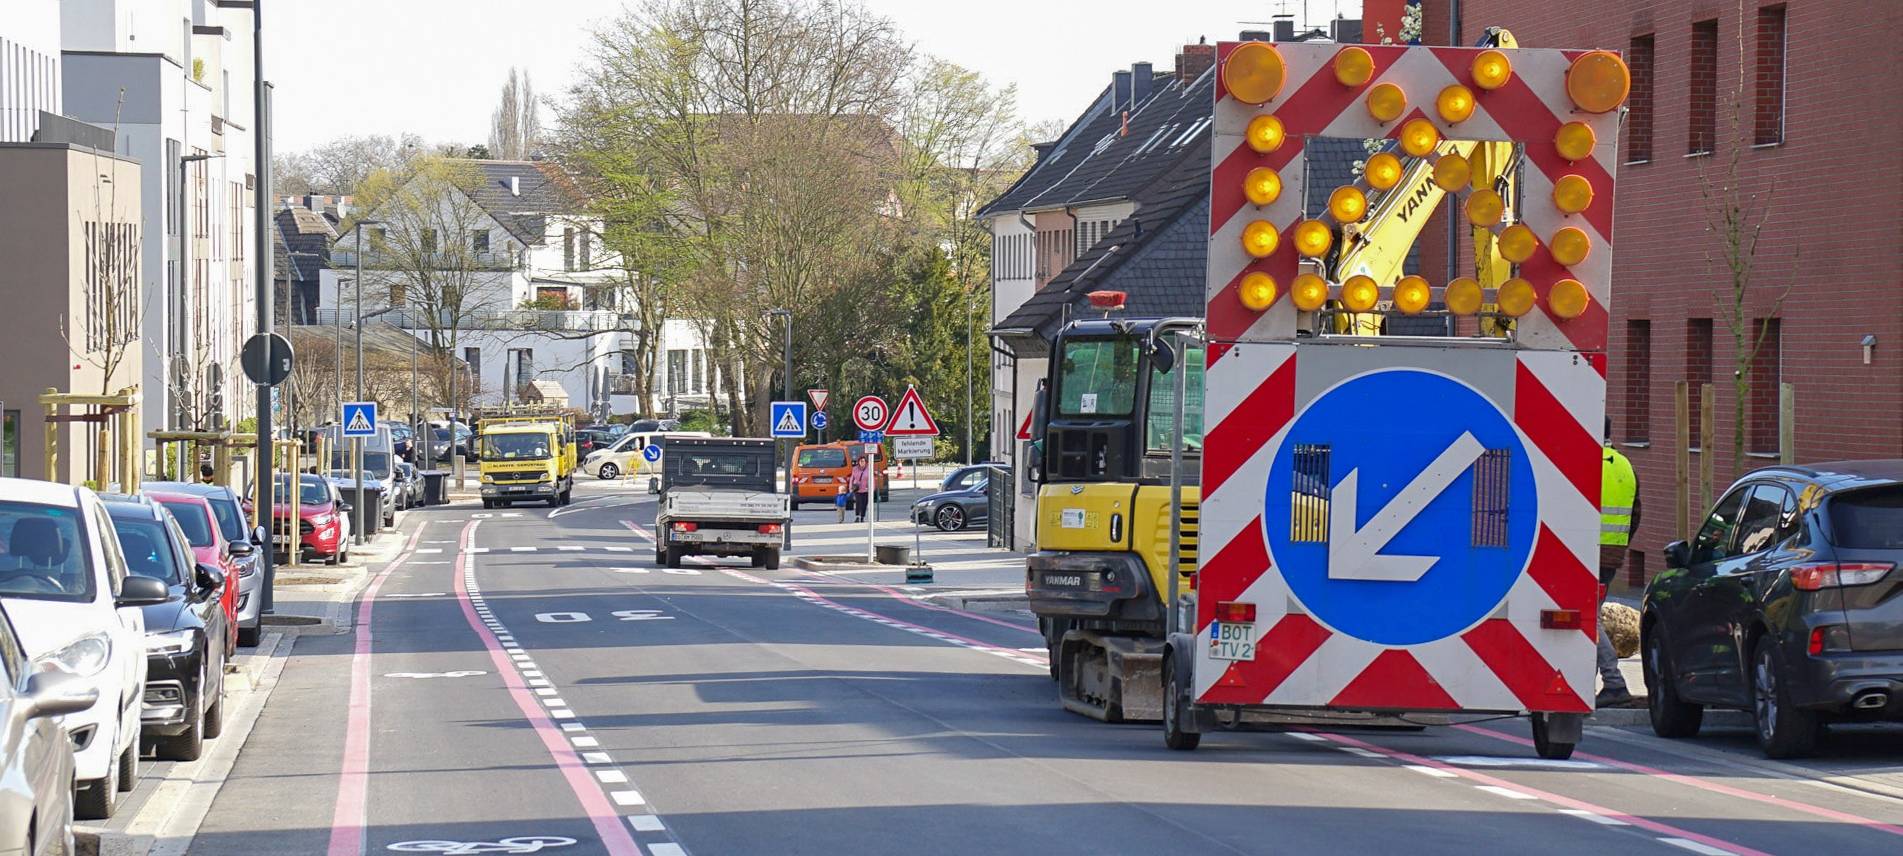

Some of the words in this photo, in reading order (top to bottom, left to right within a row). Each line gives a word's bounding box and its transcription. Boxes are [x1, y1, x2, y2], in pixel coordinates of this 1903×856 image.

[861, 406, 881, 421] 30
[1045, 576, 1081, 586] YANMAR
[1222, 625, 1252, 640] BOT
[1220, 641, 1239, 657] TV
[1242, 643, 1252, 658] 2
